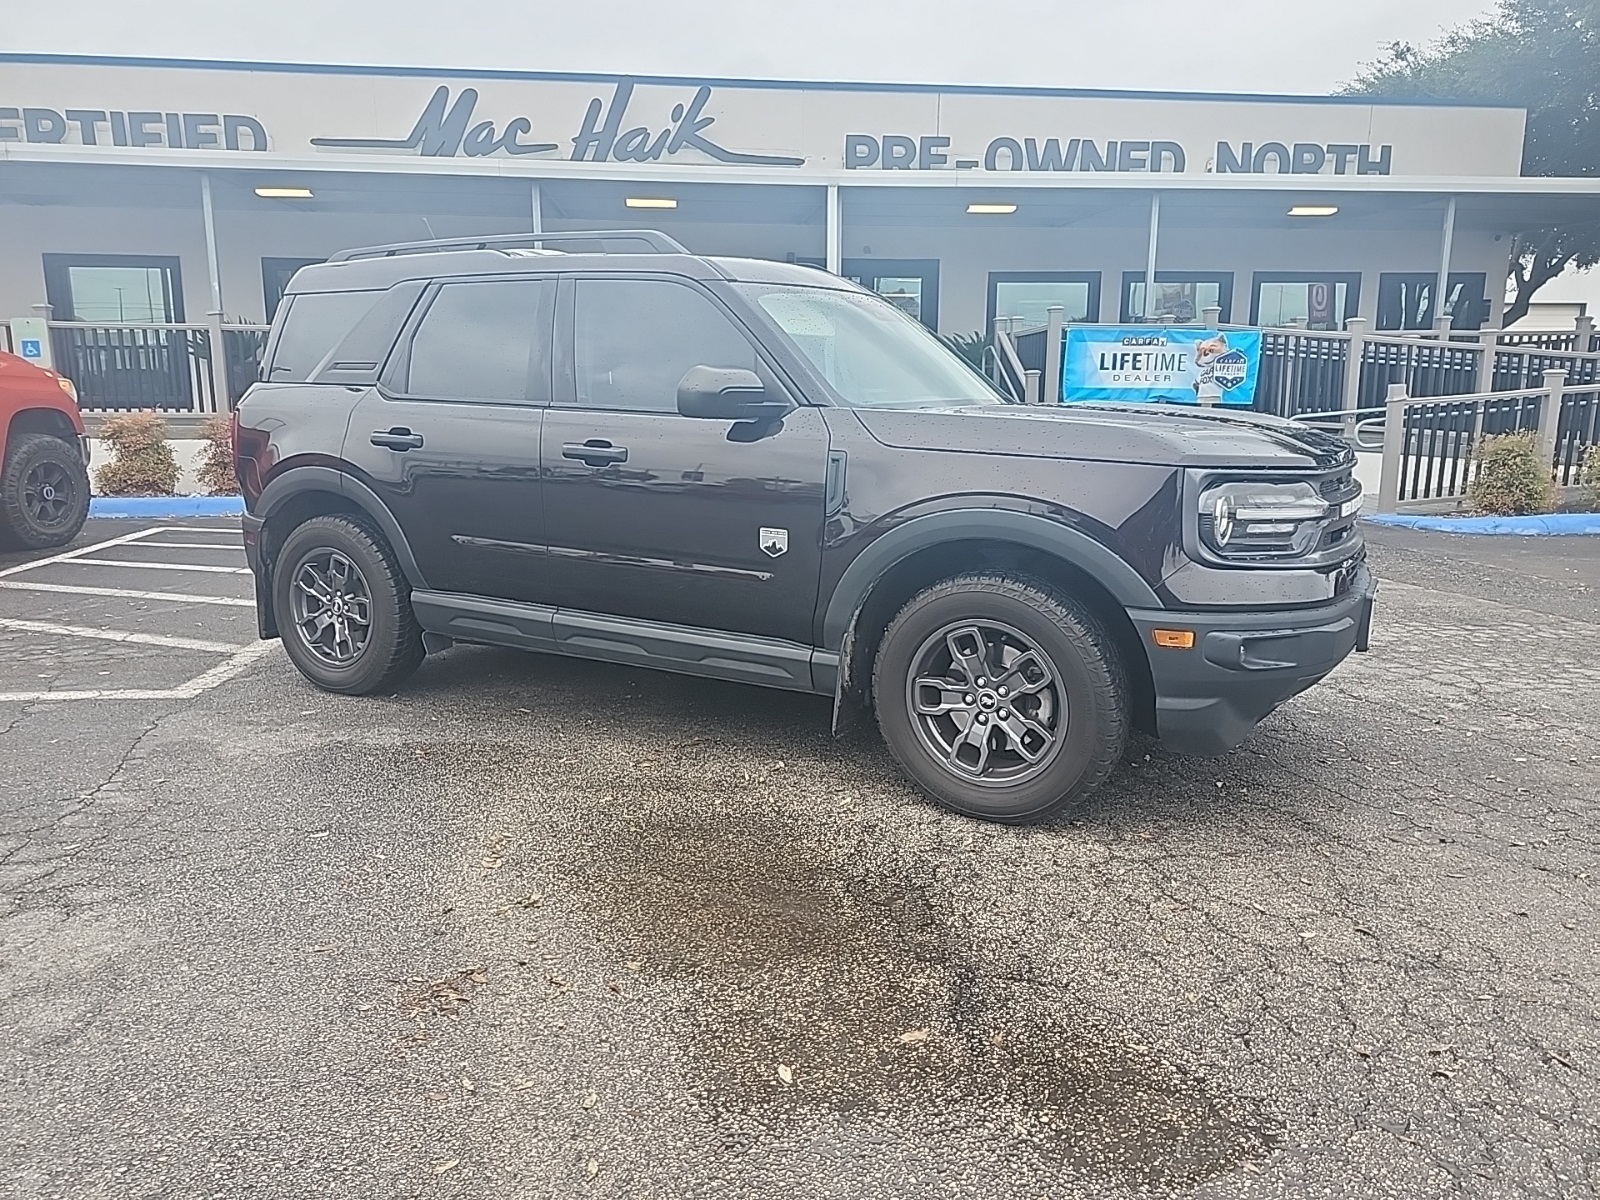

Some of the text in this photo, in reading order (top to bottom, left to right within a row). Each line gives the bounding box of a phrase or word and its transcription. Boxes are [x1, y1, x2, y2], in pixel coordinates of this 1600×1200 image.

[310, 74, 805, 166] Mac Haik
[845, 134, 1393, 175] PRE-OWNED NORTH
[1122, 337, 1168, 347] CARFAX
[1099, 352, 1188, 372] LIFETIME
[1113, 374, 1171, 382] DEALER
